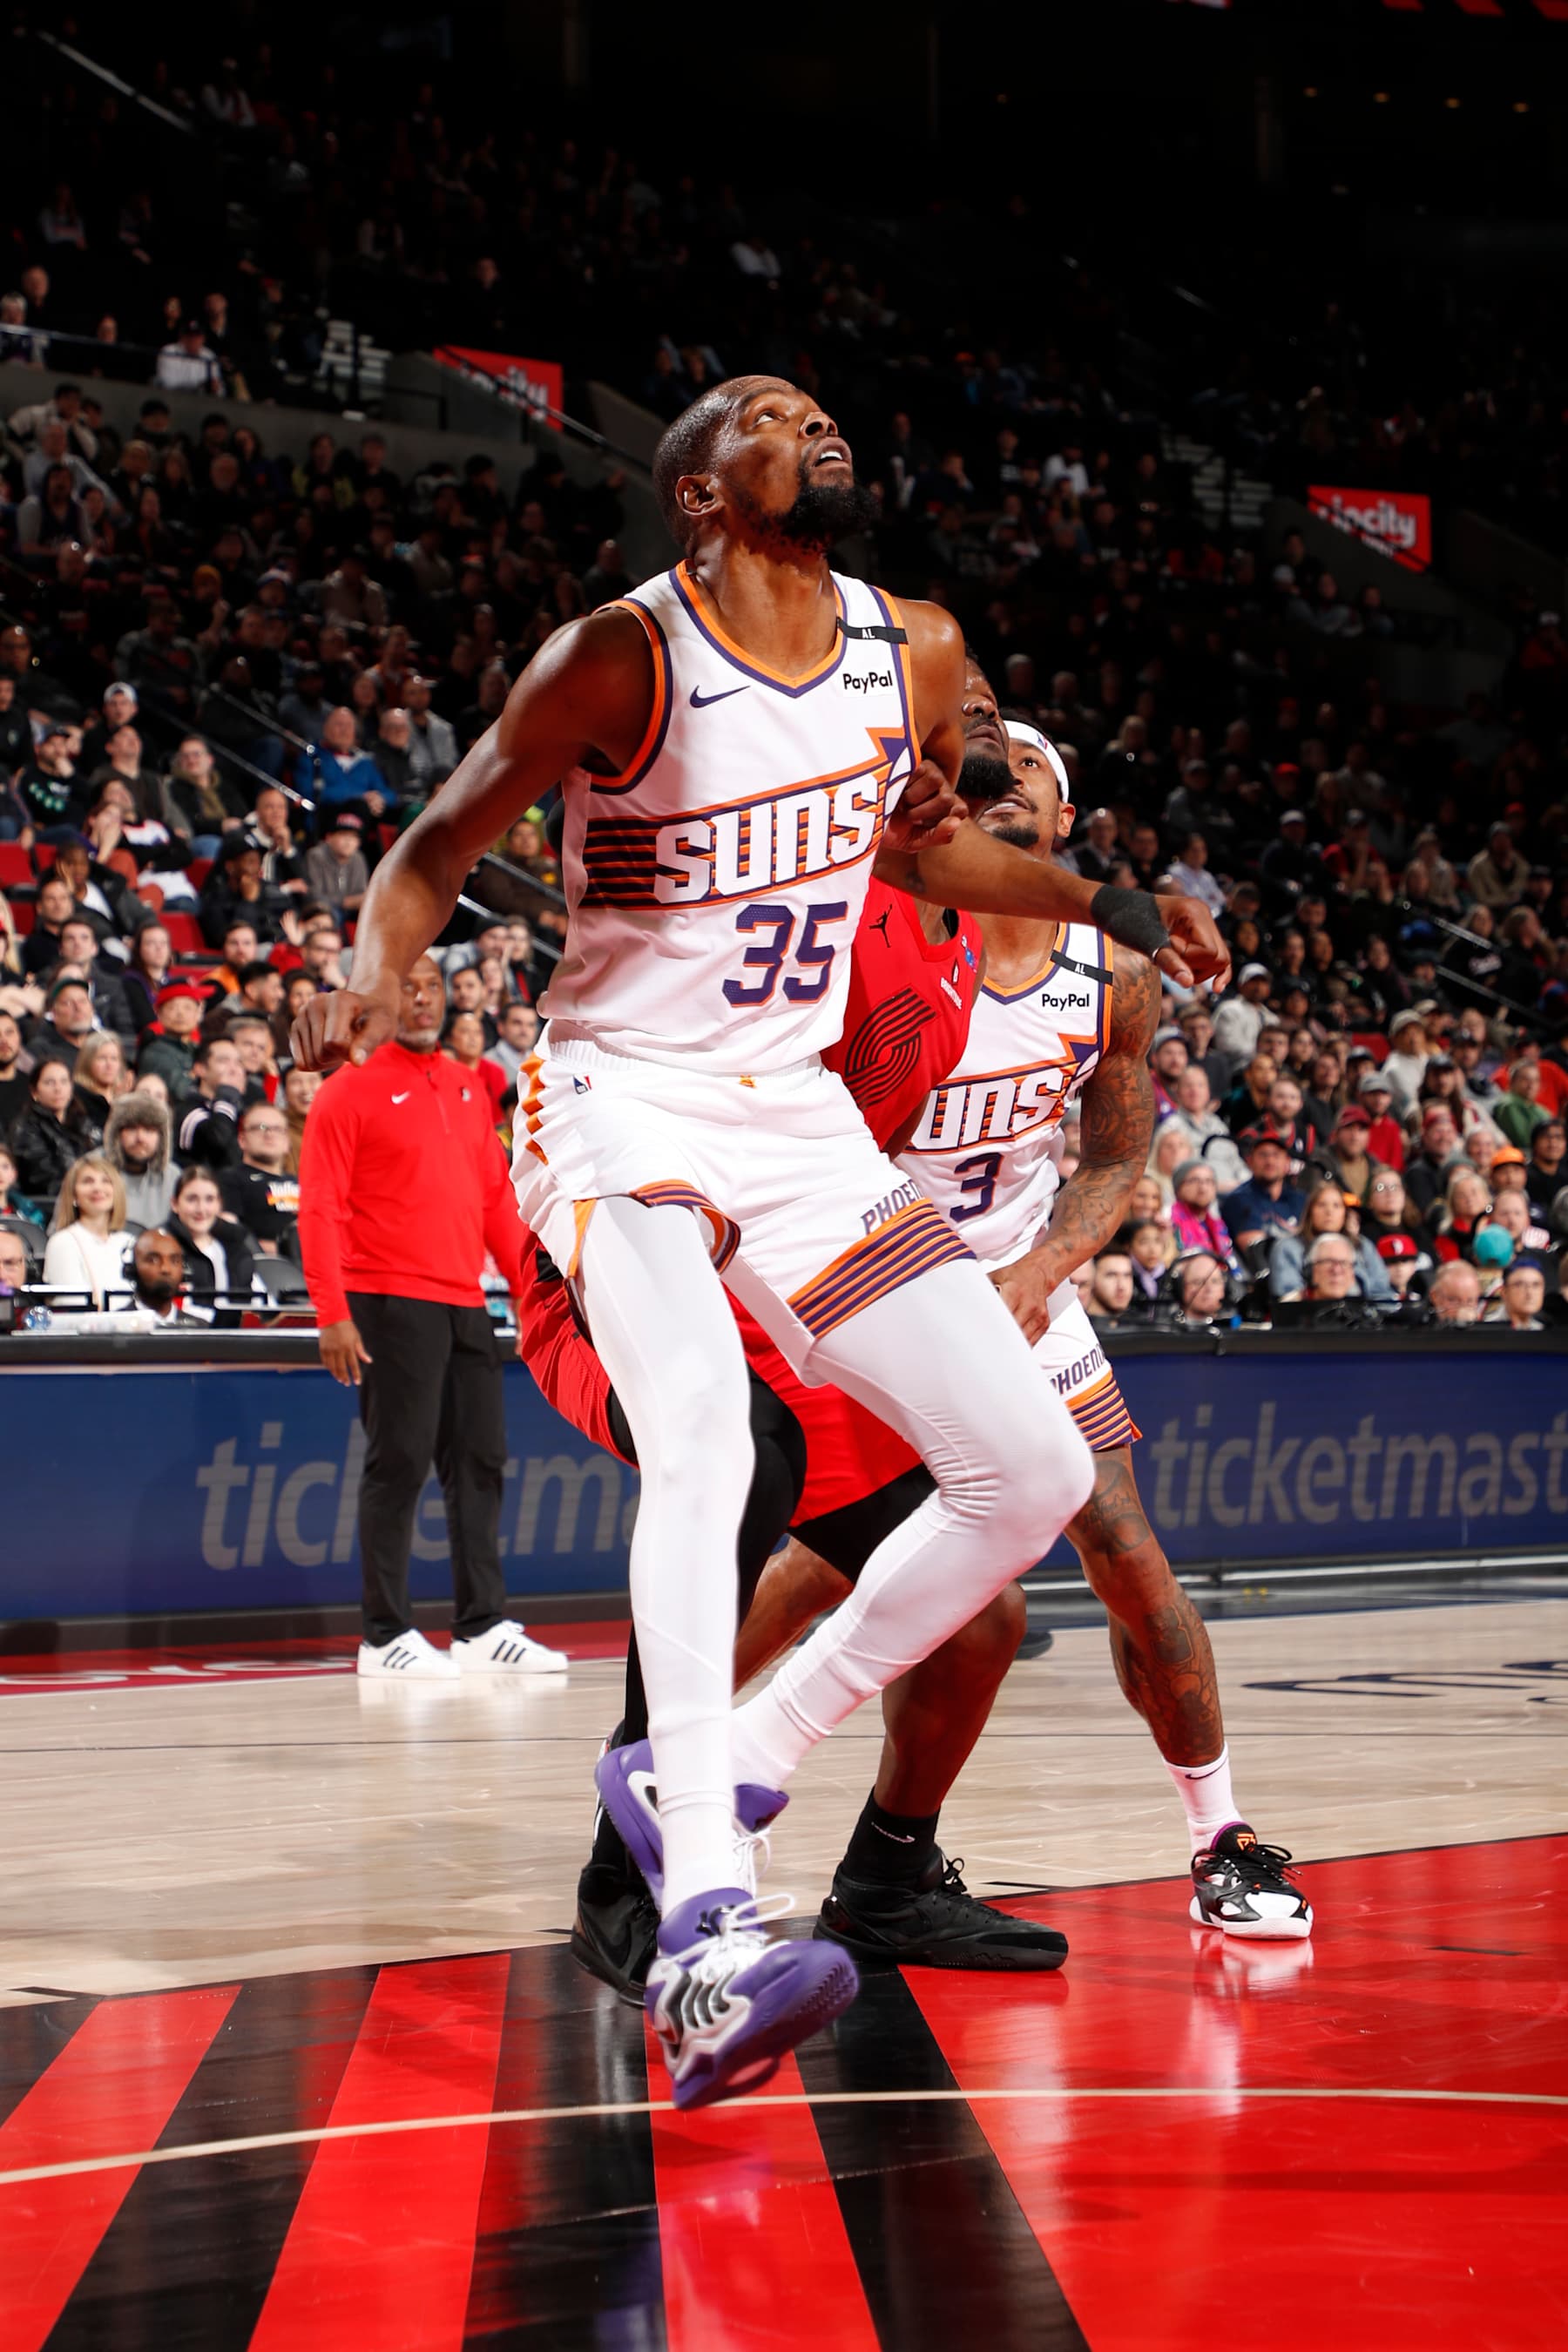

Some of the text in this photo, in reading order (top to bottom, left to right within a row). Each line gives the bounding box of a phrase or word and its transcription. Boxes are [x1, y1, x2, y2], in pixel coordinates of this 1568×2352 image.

[862, 628, 875, 639] AL
[842, 670, 893, 694] PayPal
[653, 772, 878, 904] SUNS
[721, 901, 848, 1008] 35
[1074, 963, 1085, 975] AL
[1042, 994, 1090, 1011] PayPal
[949, 1152, 1004, 1220] 3
